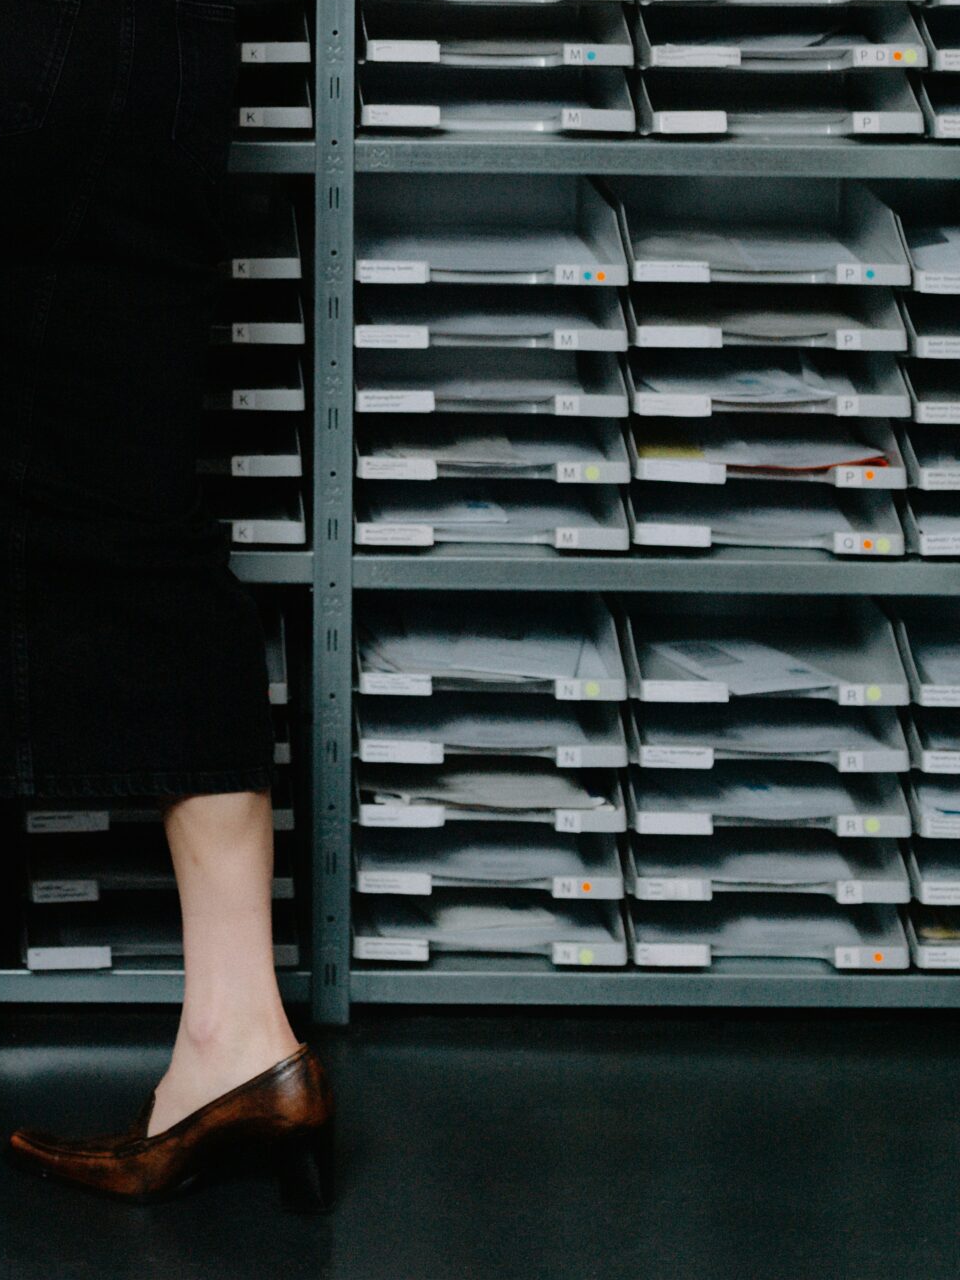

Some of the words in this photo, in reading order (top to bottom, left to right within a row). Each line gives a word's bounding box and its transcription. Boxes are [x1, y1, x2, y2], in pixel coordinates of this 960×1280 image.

[250, 50, 258, 60] K
[570, 49, 581, 59] M
[860, 50, 868, 60] P
[876, 50, 885, 61] D
[246, 112, 255, 123] K
[568, 112, 579, 122] M
[863, 117, 871, 128] P
[238, 263, 245, 273] K
[845, 268, 855, 279] P
[562, 269, 574, 280] M
[237, 328, 243, 336] K
[561, 335, 572, 345] M
[844, 334, 853, 345] P
[239, 395, 247, 405] K
[562, 401, 573, 410] M
[845, 400, 853, 410] P
[237, 461, 245, 472] K
[564, 467, 575, 478] M
[846, 471, 855, 482] P
[238, 527, 246, 538] K
[562, 533, 573, 543] M
[847, 690, 856, 701] R
[565, 751, 575, 762] N
[847, 756, 856, 767] R
[846, 820, 856, 831] R
[561, 882, 571, 893] N
[845, 885, 855, 896] R
